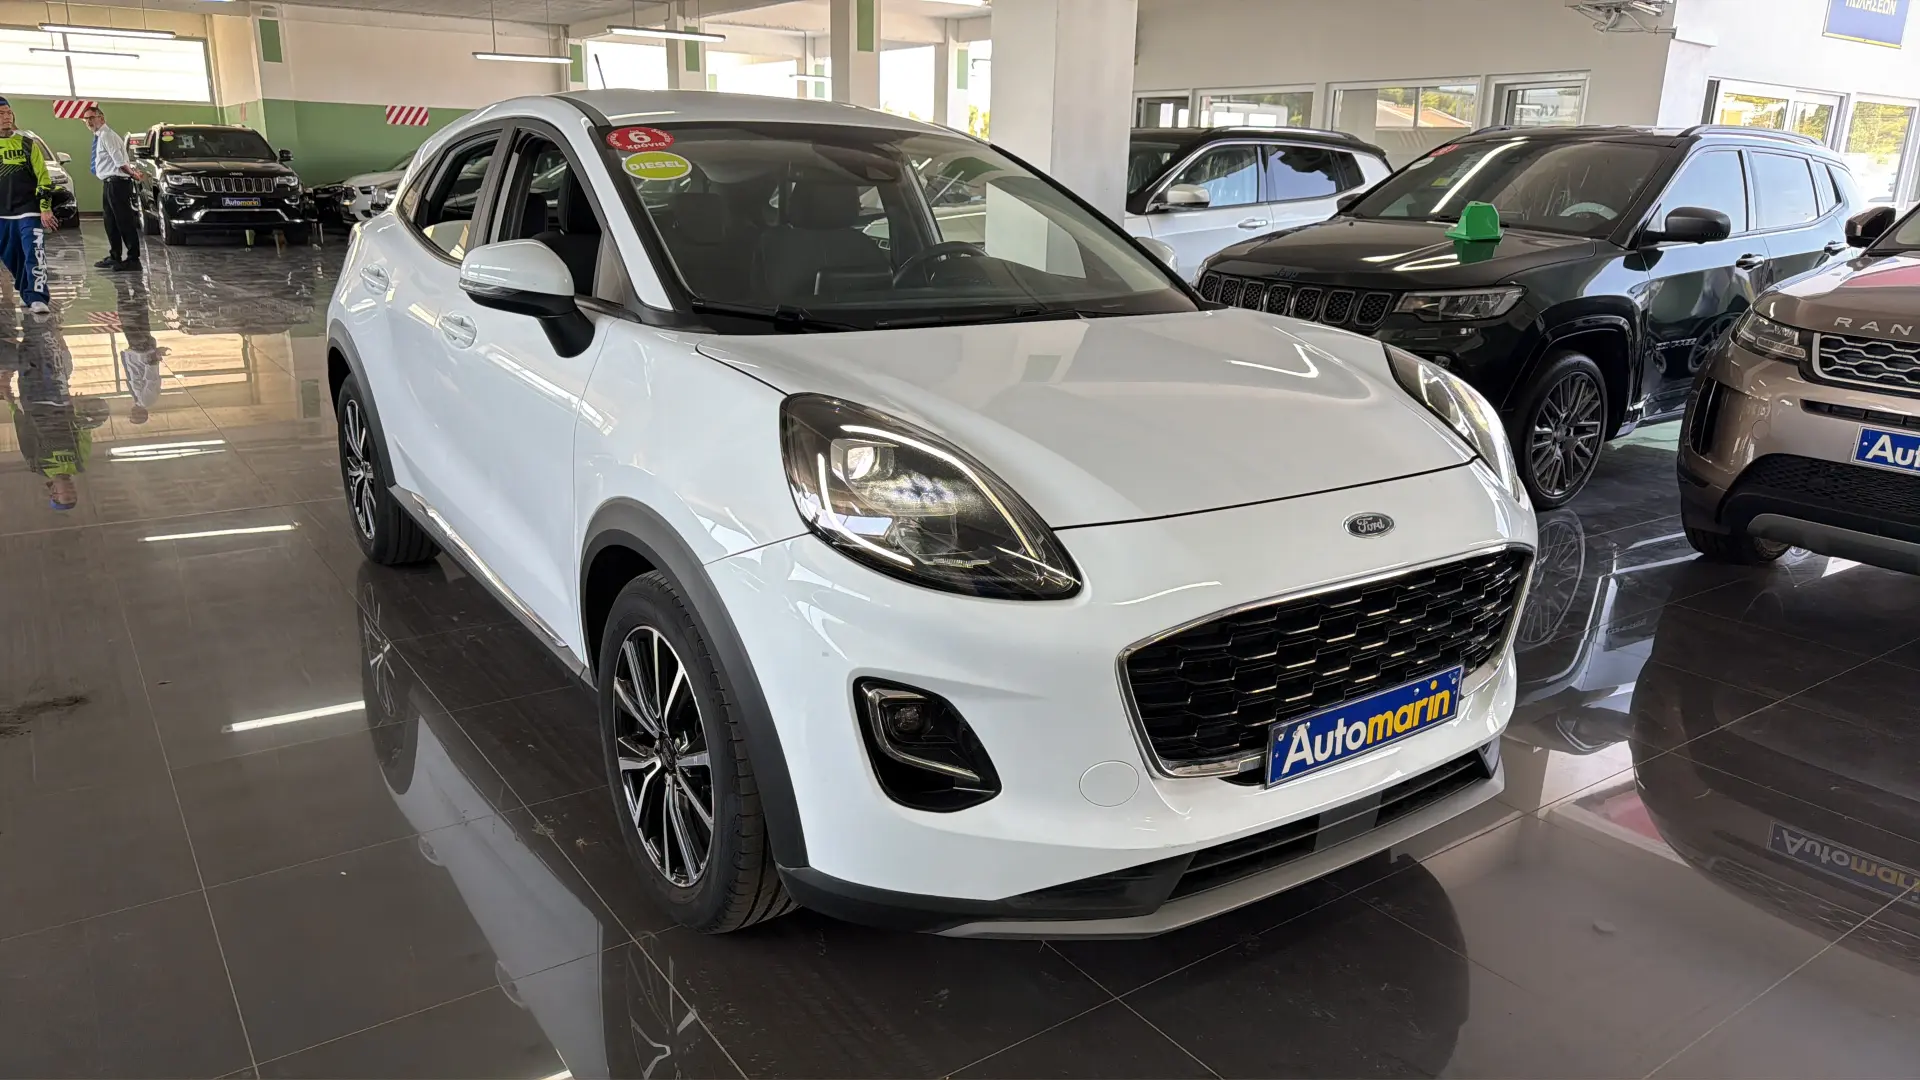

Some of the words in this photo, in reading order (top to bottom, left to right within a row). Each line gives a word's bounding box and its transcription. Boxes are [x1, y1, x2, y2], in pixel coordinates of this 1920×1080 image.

[629, 131, 651, 143] 6
[626, 141, 667, 150] χρόνια
[629, 161, 685, 171] DIESEL
[1834, 317, 1914, 335] RAN
[1357, 517, 1385, 533] Ford
[1281, 680, 1450, 774] Automarin
